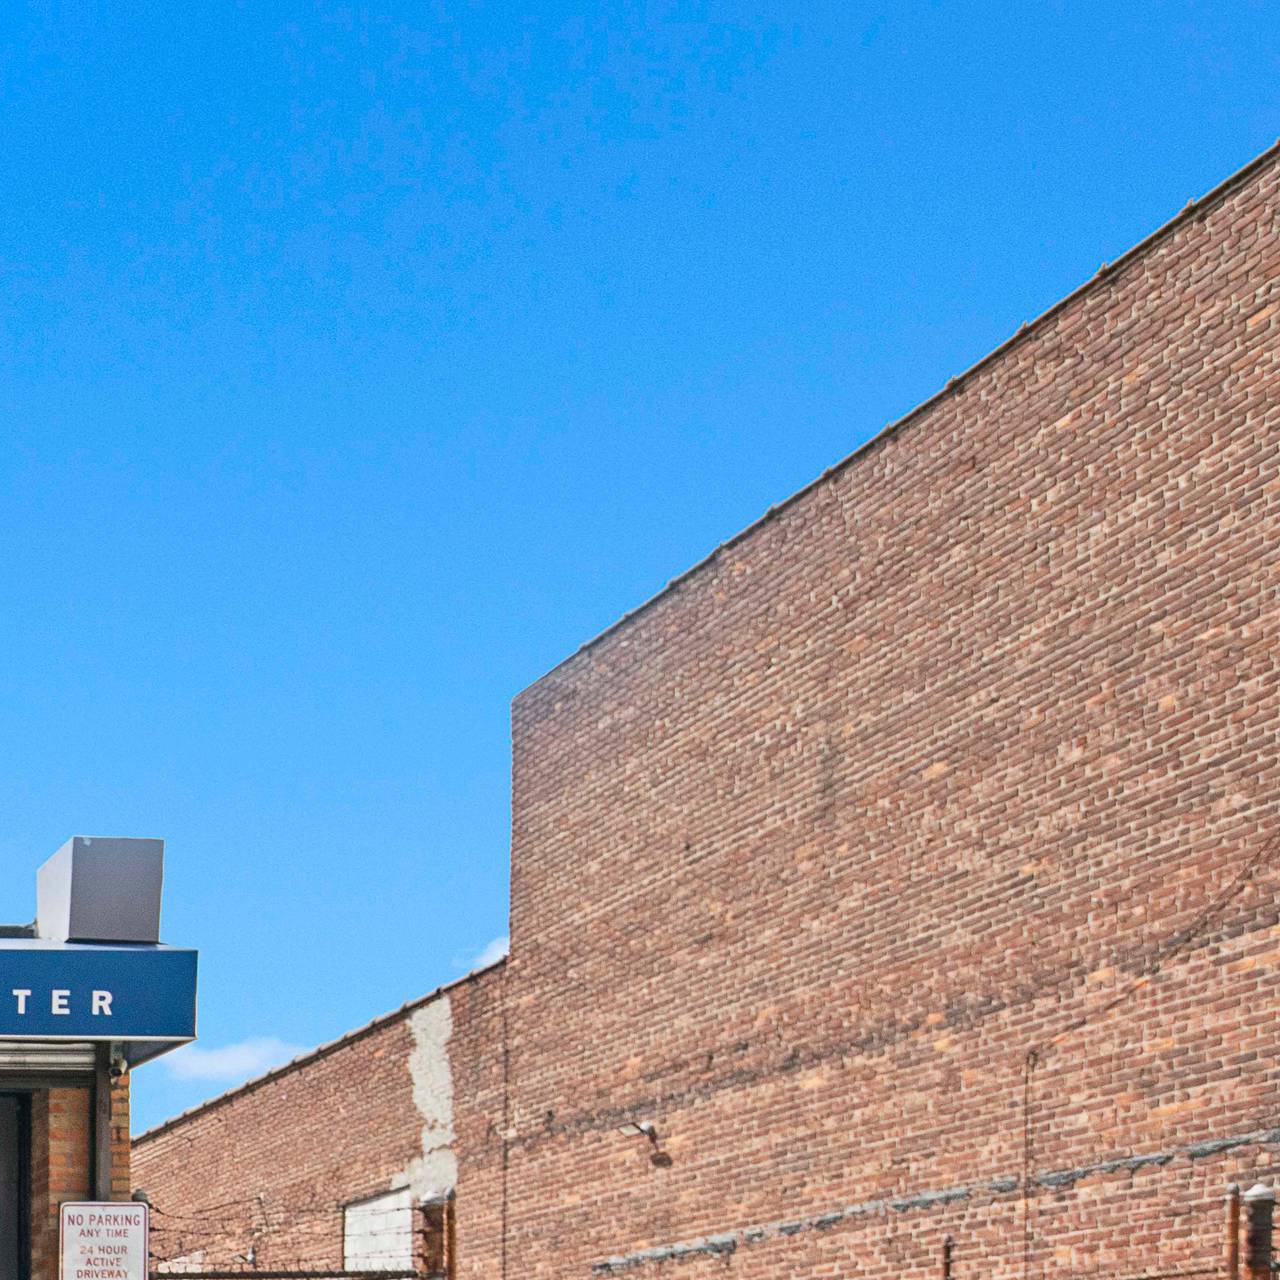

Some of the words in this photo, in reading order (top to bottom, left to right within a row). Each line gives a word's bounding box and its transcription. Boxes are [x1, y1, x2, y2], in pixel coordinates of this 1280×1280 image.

[67, 1214, 84, 1226] NO
[89, 1214, 140, 1226] PARKING
[79, 1228, 101, 1238] ANY
[105, 1228, 129, 1238] TIME
[80, 1245, 93, 1255] 24
[98, 1245, 128, 1255] HOUR
[85, 1257, 122, 1267] ACTIVE
[76, 1269, 129, 1279] DRIVEWAY
